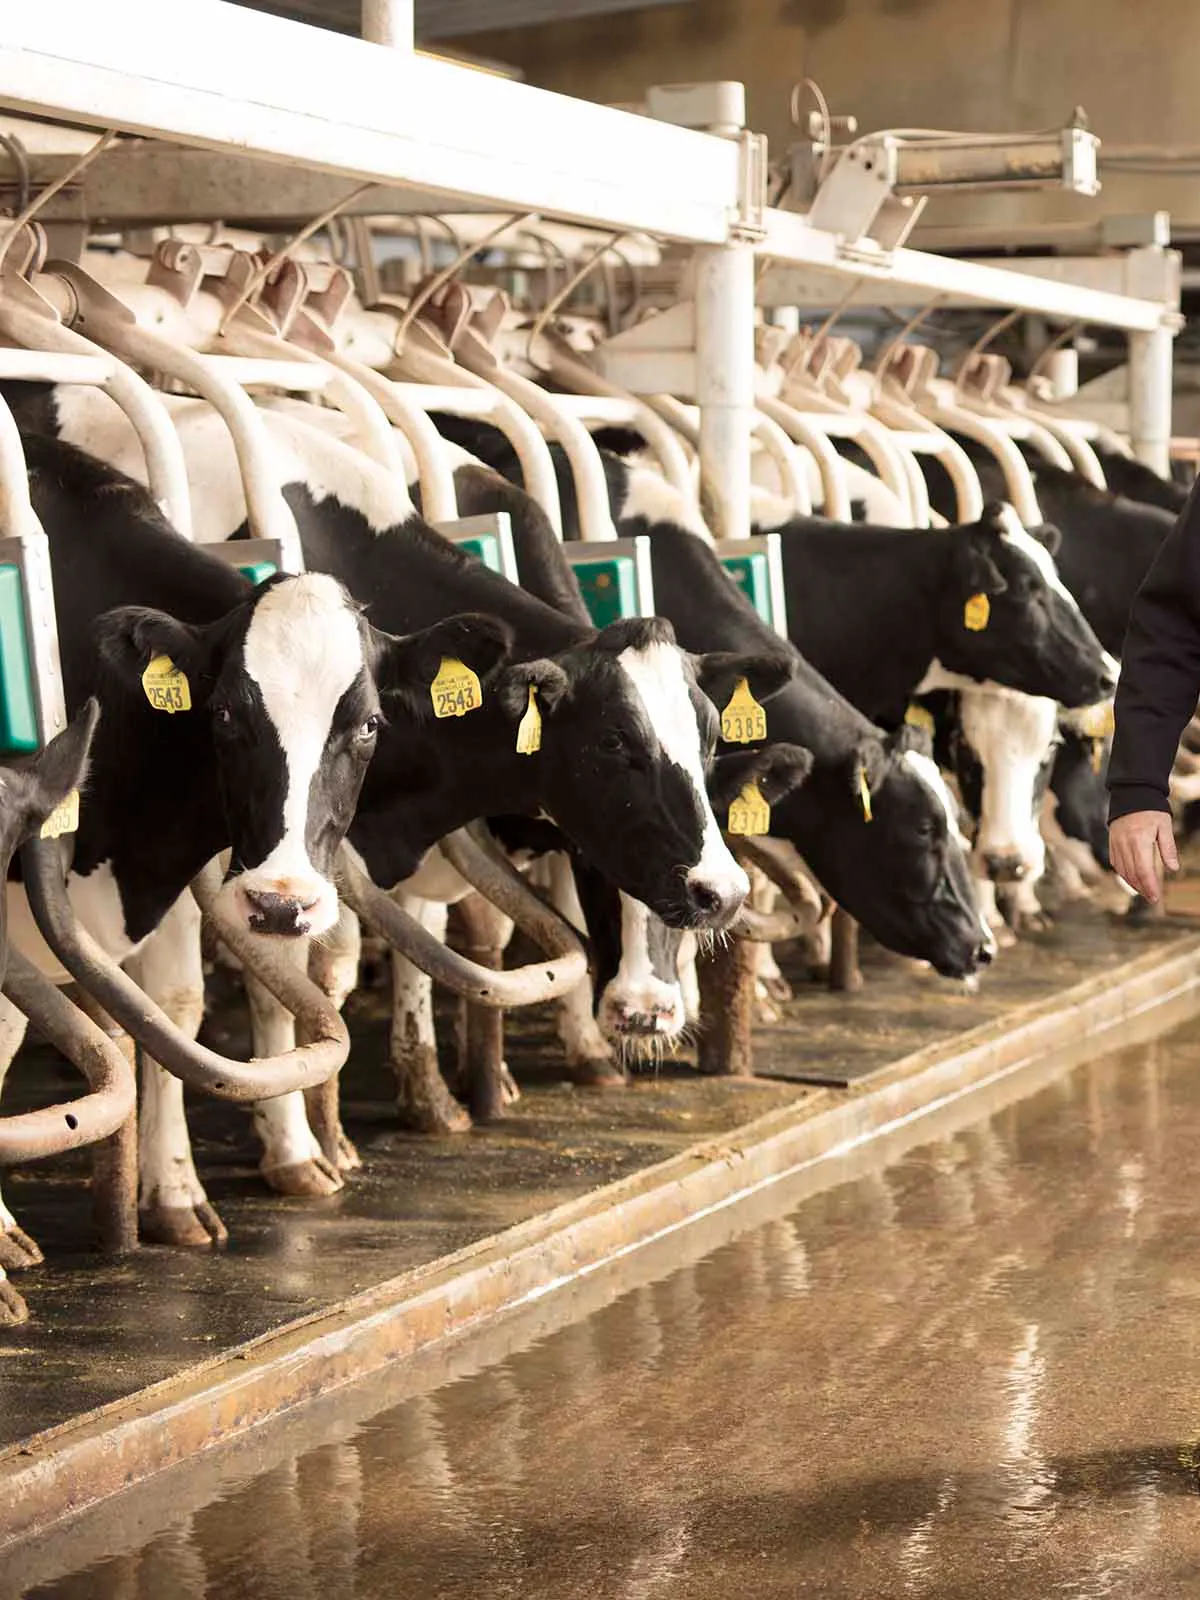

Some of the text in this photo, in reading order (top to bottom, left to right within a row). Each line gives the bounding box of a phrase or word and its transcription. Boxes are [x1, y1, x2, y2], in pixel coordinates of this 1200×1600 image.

[149, 687, 183, 710] 2543
[437, 687, 474, 716] 2543
[724, 716, 764, 740] 2385
[731, 811, 767, 832] 2371
